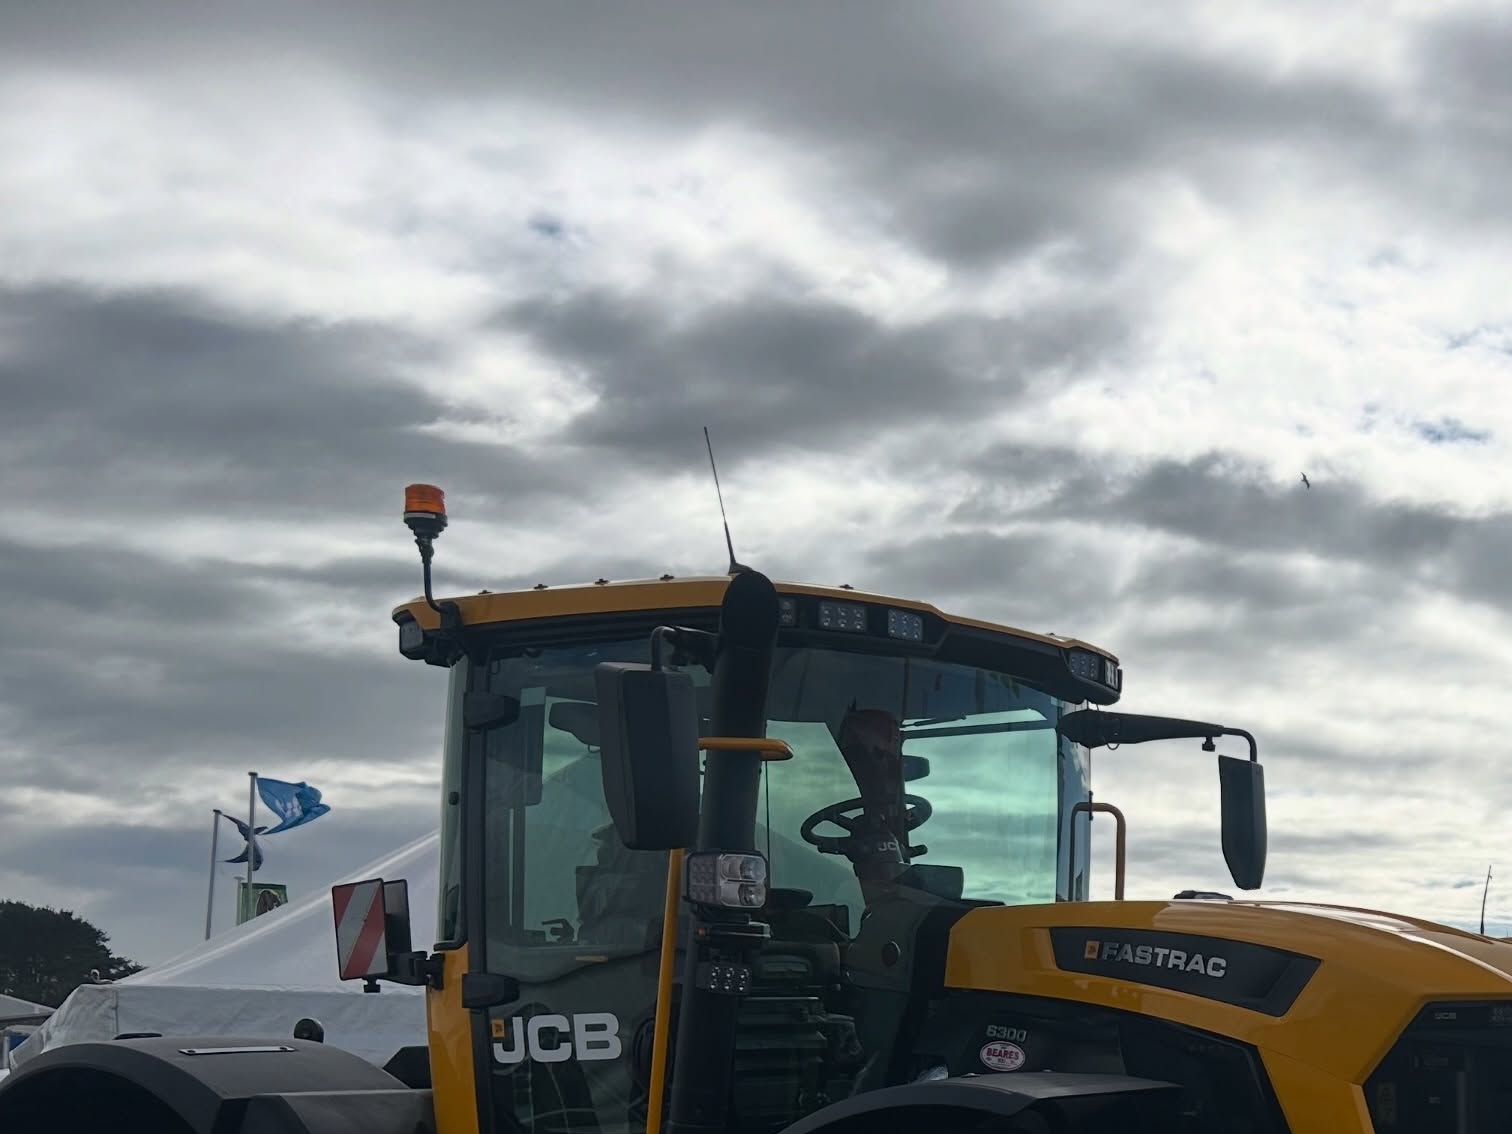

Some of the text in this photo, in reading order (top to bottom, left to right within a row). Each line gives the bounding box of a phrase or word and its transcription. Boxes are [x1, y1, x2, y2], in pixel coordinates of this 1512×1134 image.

[1101, 941, 1228, 978] FASTRAC
[493, 1012, 622, 1064] JCB
[986, 1048, 1020, 1060] BEARES
